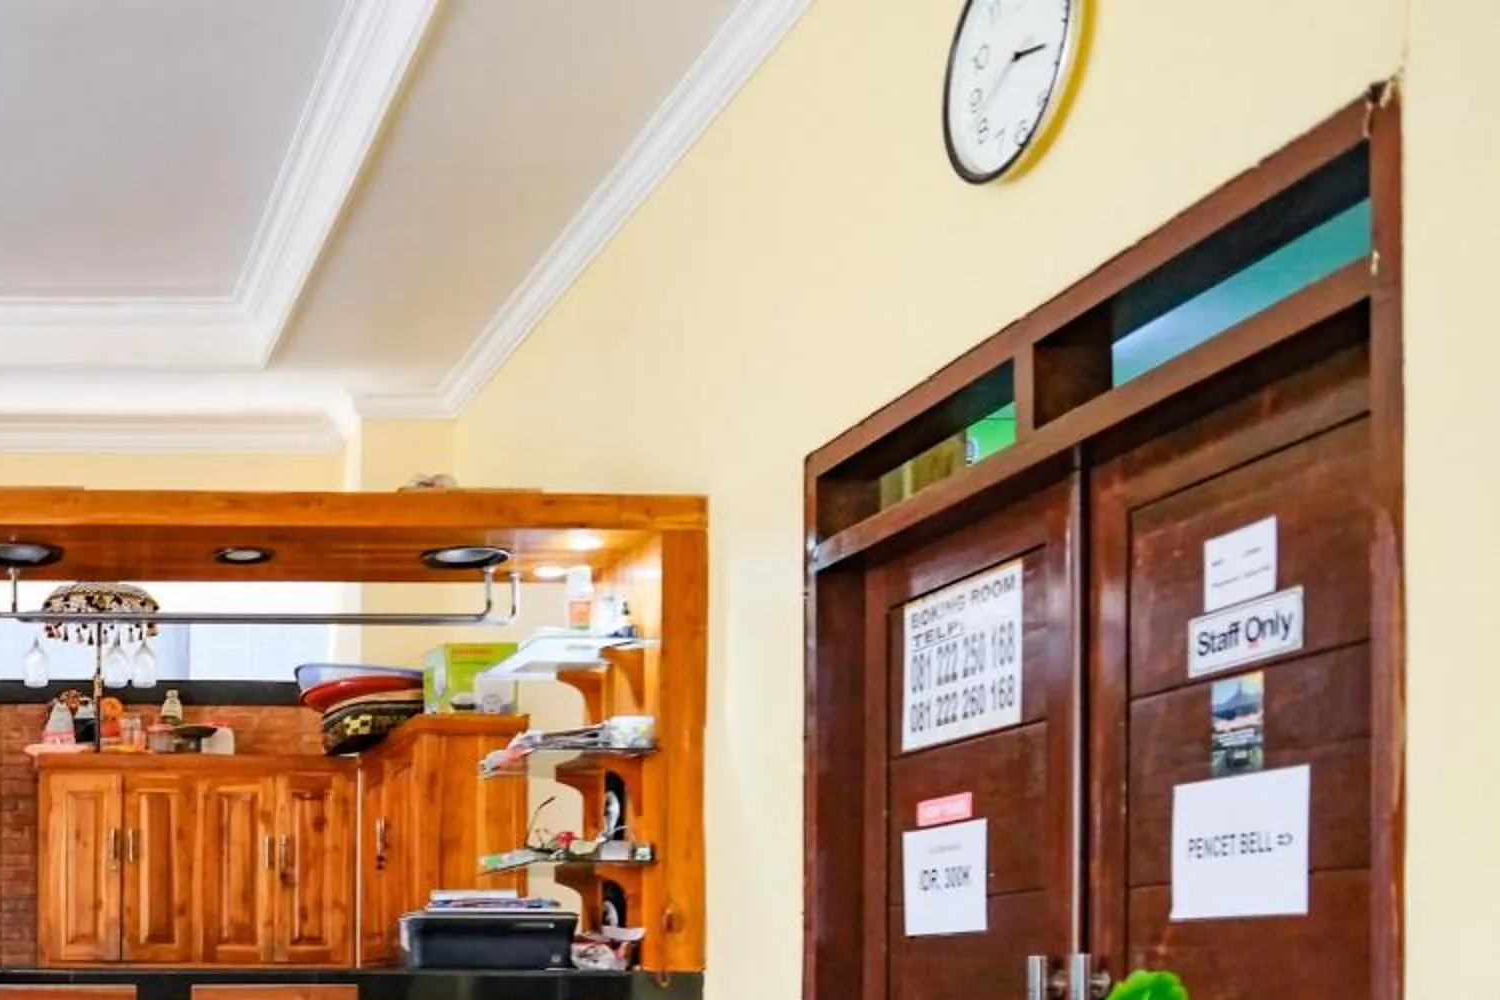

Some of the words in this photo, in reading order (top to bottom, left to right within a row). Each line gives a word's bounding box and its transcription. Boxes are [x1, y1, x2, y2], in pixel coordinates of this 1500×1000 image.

[911, 594, 966, 630] BOKING
[971, 573, 1016, 604] ROOM
[911, 651, 932, 694] 081
[937, 641, 959, 686] 222
[991, 620, 1015, 669] 168
[1197, 620, 1241, 657] Staff
[1245, 609, 1294, 643] Only
[910, 700, 932, 734] 081
[936, 690, 959, 727] 222
[991, 673, 1015, 712] 168
[1188, 832, 1236, 861] PENCET
[1240, 830, 1274, 855] BELL
